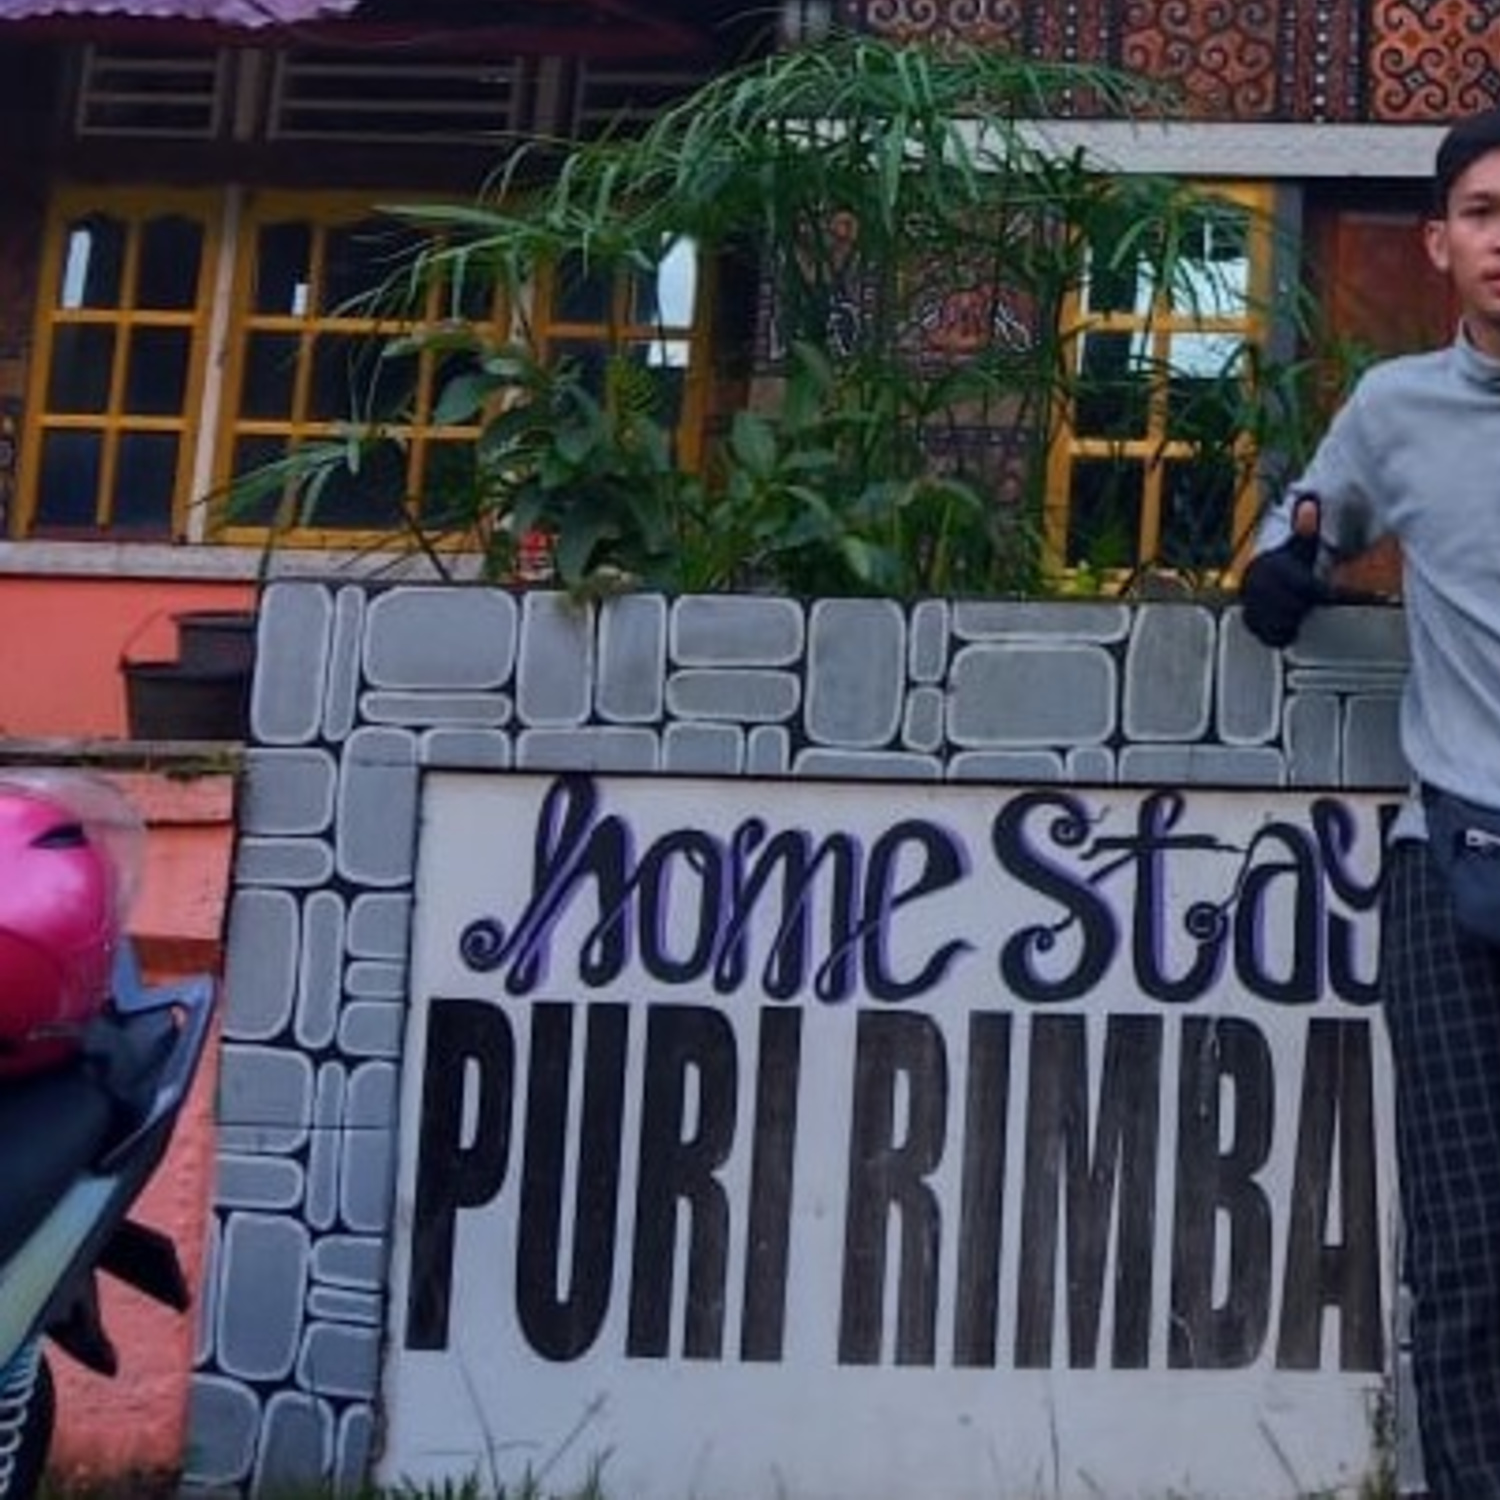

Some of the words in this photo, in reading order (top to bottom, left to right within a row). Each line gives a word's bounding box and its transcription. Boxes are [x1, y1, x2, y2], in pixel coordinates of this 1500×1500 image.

[459, 773, 976, 1002] home
[404, 998, 803, 1362] PURI
[837, 1009, 1385, 1371] RIMBA
